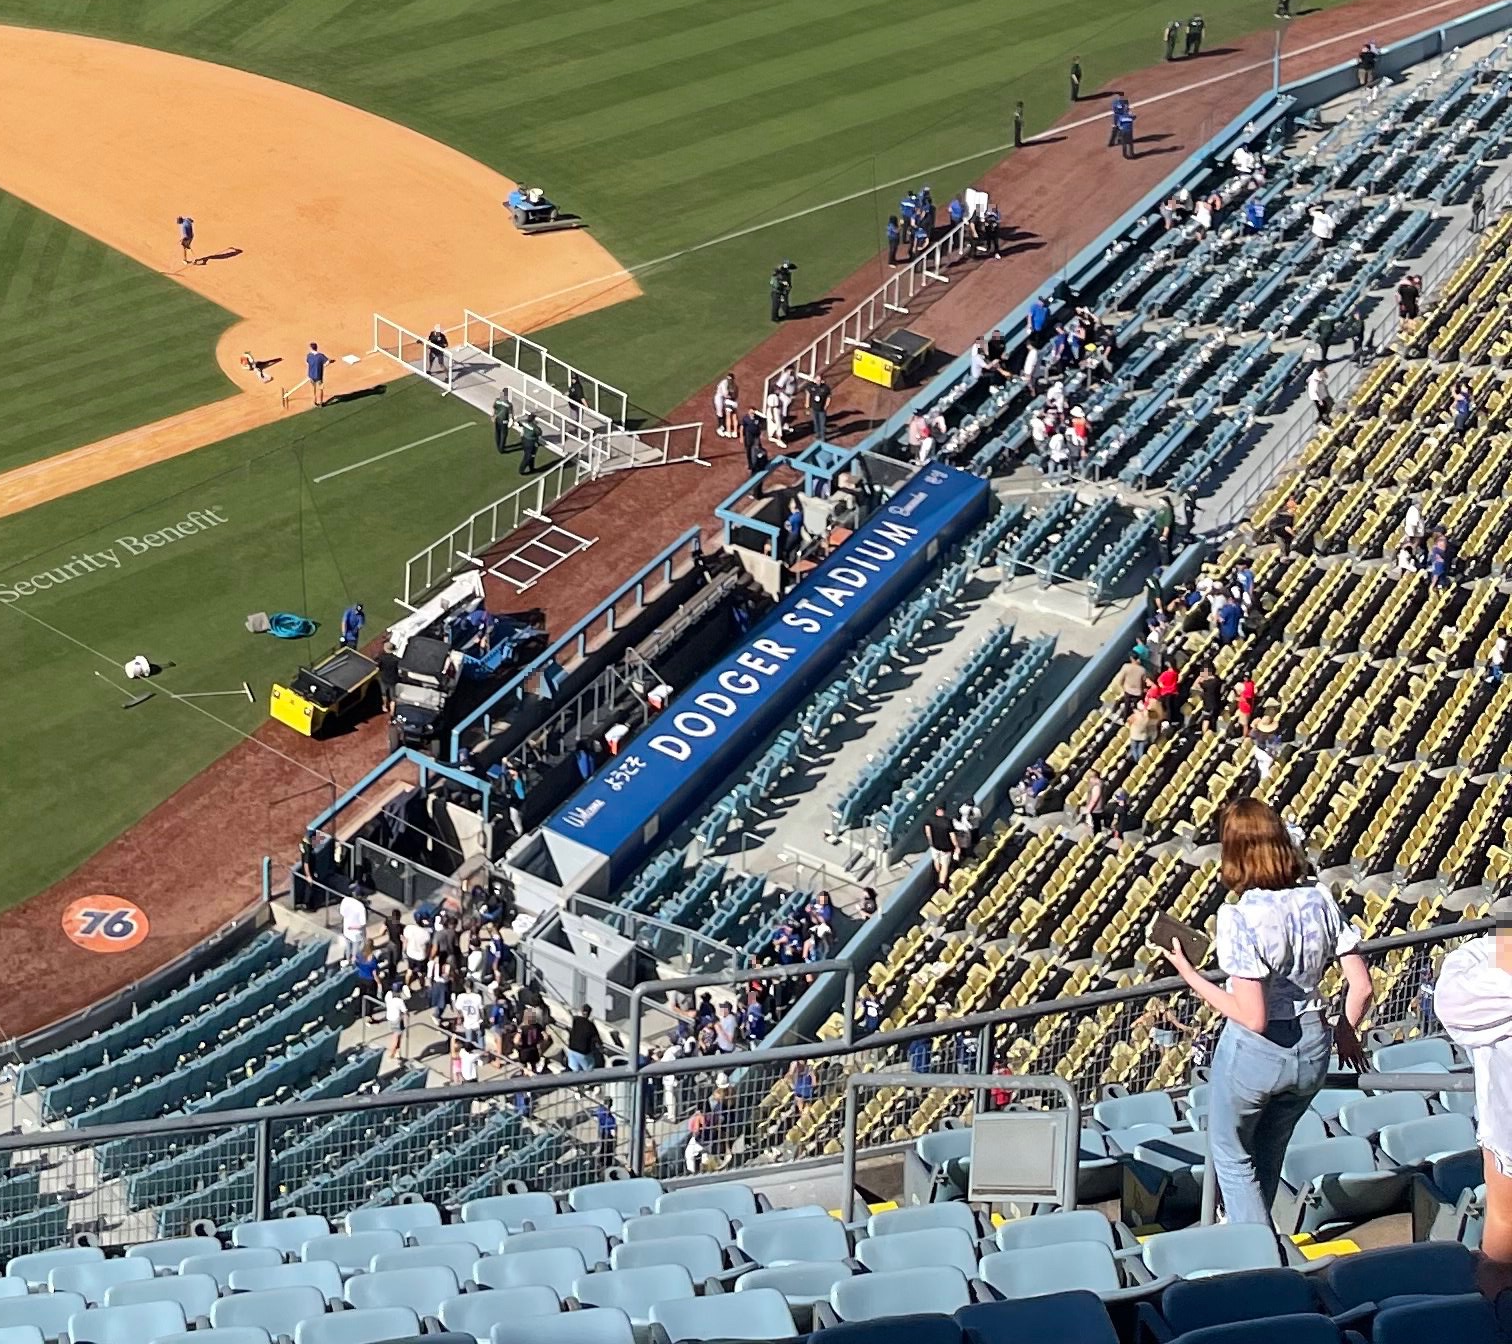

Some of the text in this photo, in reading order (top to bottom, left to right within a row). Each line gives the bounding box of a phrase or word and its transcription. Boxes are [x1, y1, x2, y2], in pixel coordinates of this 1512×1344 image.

[115, 510, 229, 557] Benefit
[648, 520, 919, 762] DODGER STADIUM
[77, 909, 136, 939] 76
